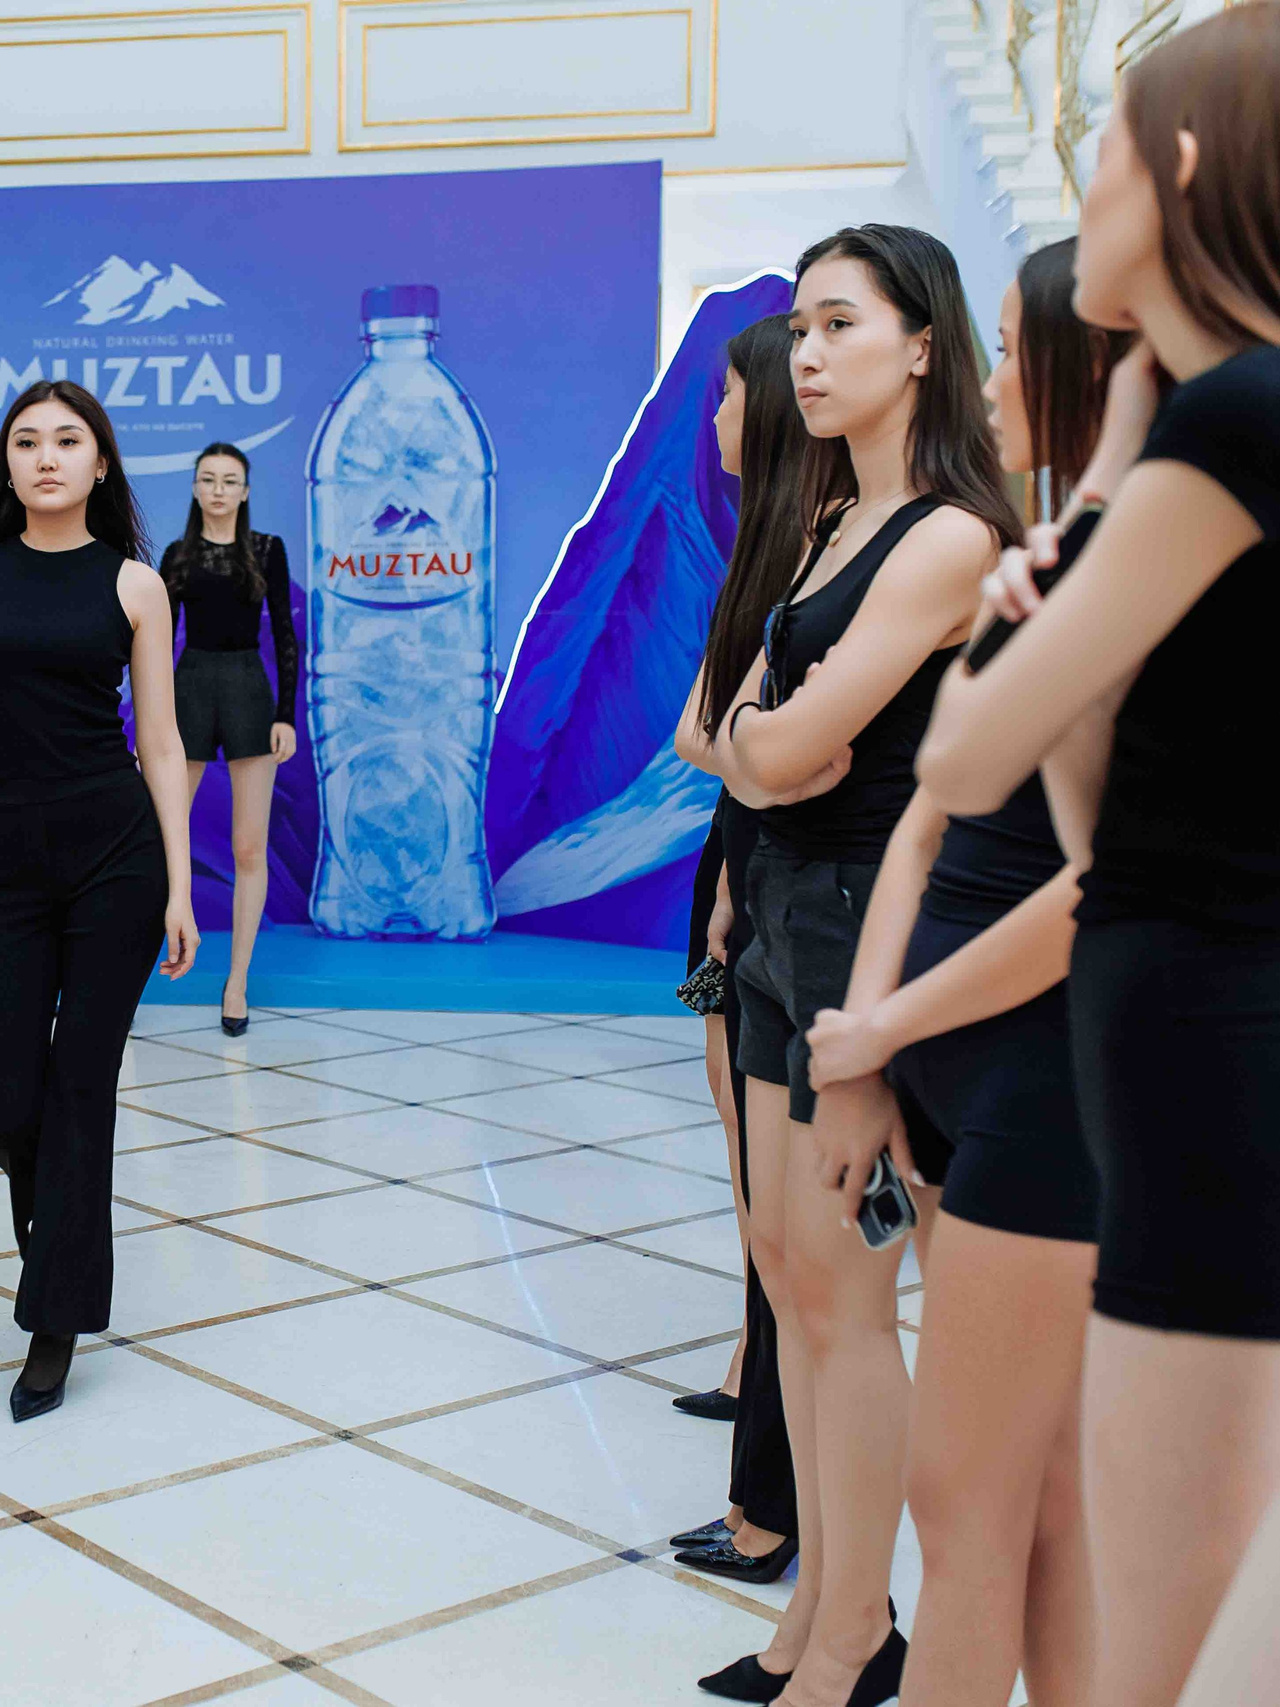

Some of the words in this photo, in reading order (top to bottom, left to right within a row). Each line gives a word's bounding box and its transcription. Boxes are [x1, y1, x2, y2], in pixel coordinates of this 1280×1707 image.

[32, 336, 99, 349] NATURAL
[105, 334, 179, 348] DRINKING
[185, 332, 235, 346] WATER
[328, 552, 472, 578] MUZTAU
